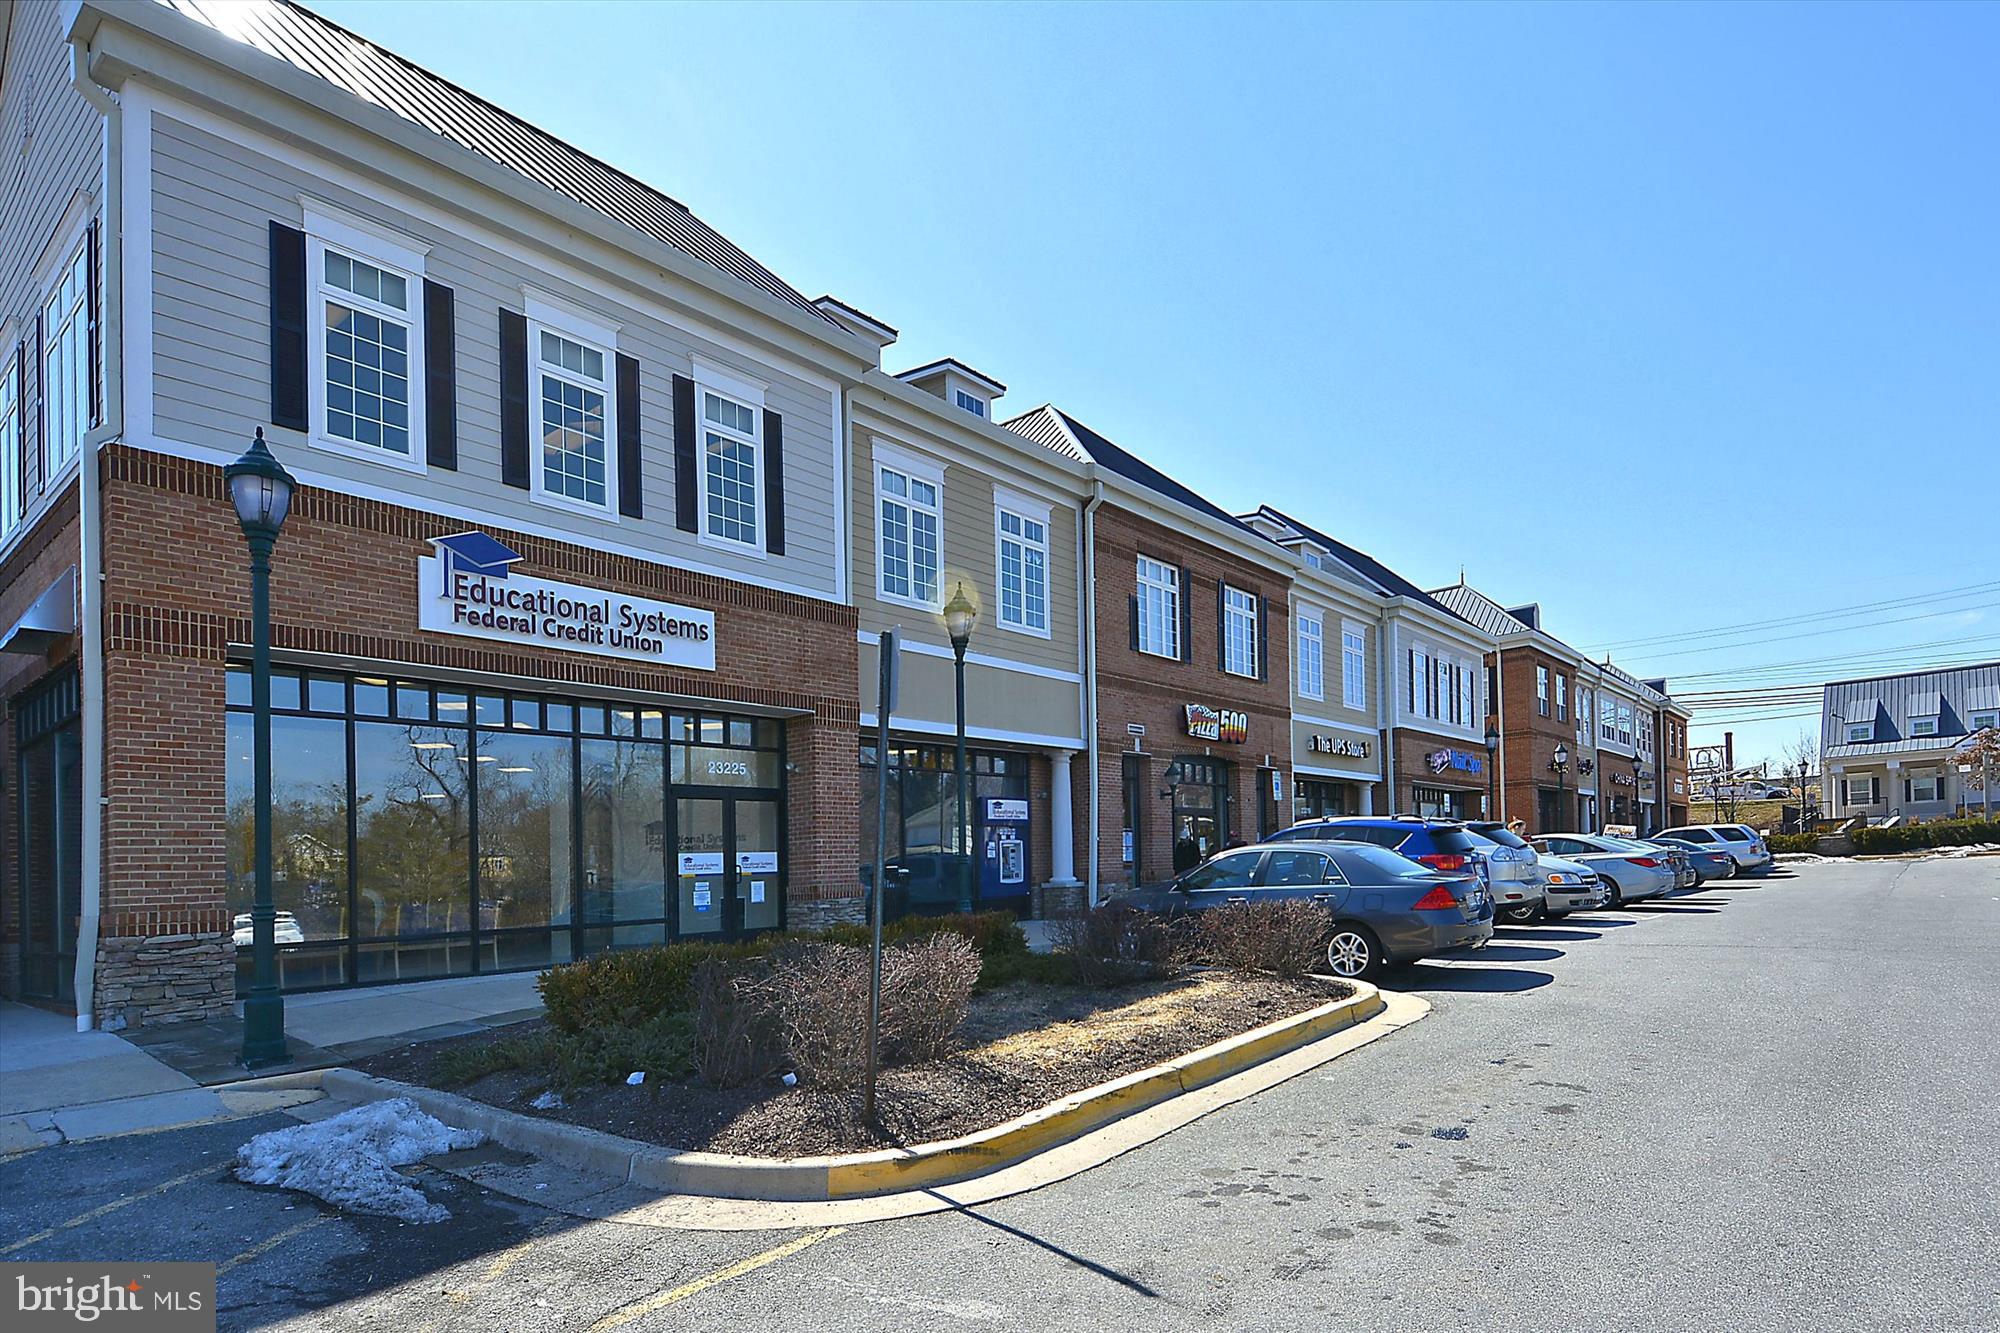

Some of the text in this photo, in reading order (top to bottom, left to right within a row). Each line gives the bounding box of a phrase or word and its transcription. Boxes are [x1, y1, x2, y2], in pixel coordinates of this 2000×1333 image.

[453, 573, 710, 642] Educational Systems
[453, 603, 664, 654] Federal Credit Union
[1220, 709, 1248, 743] 500
[1316, 735, 1365, 758] The UPS Store
[708, 761, 747, 775] 23225
